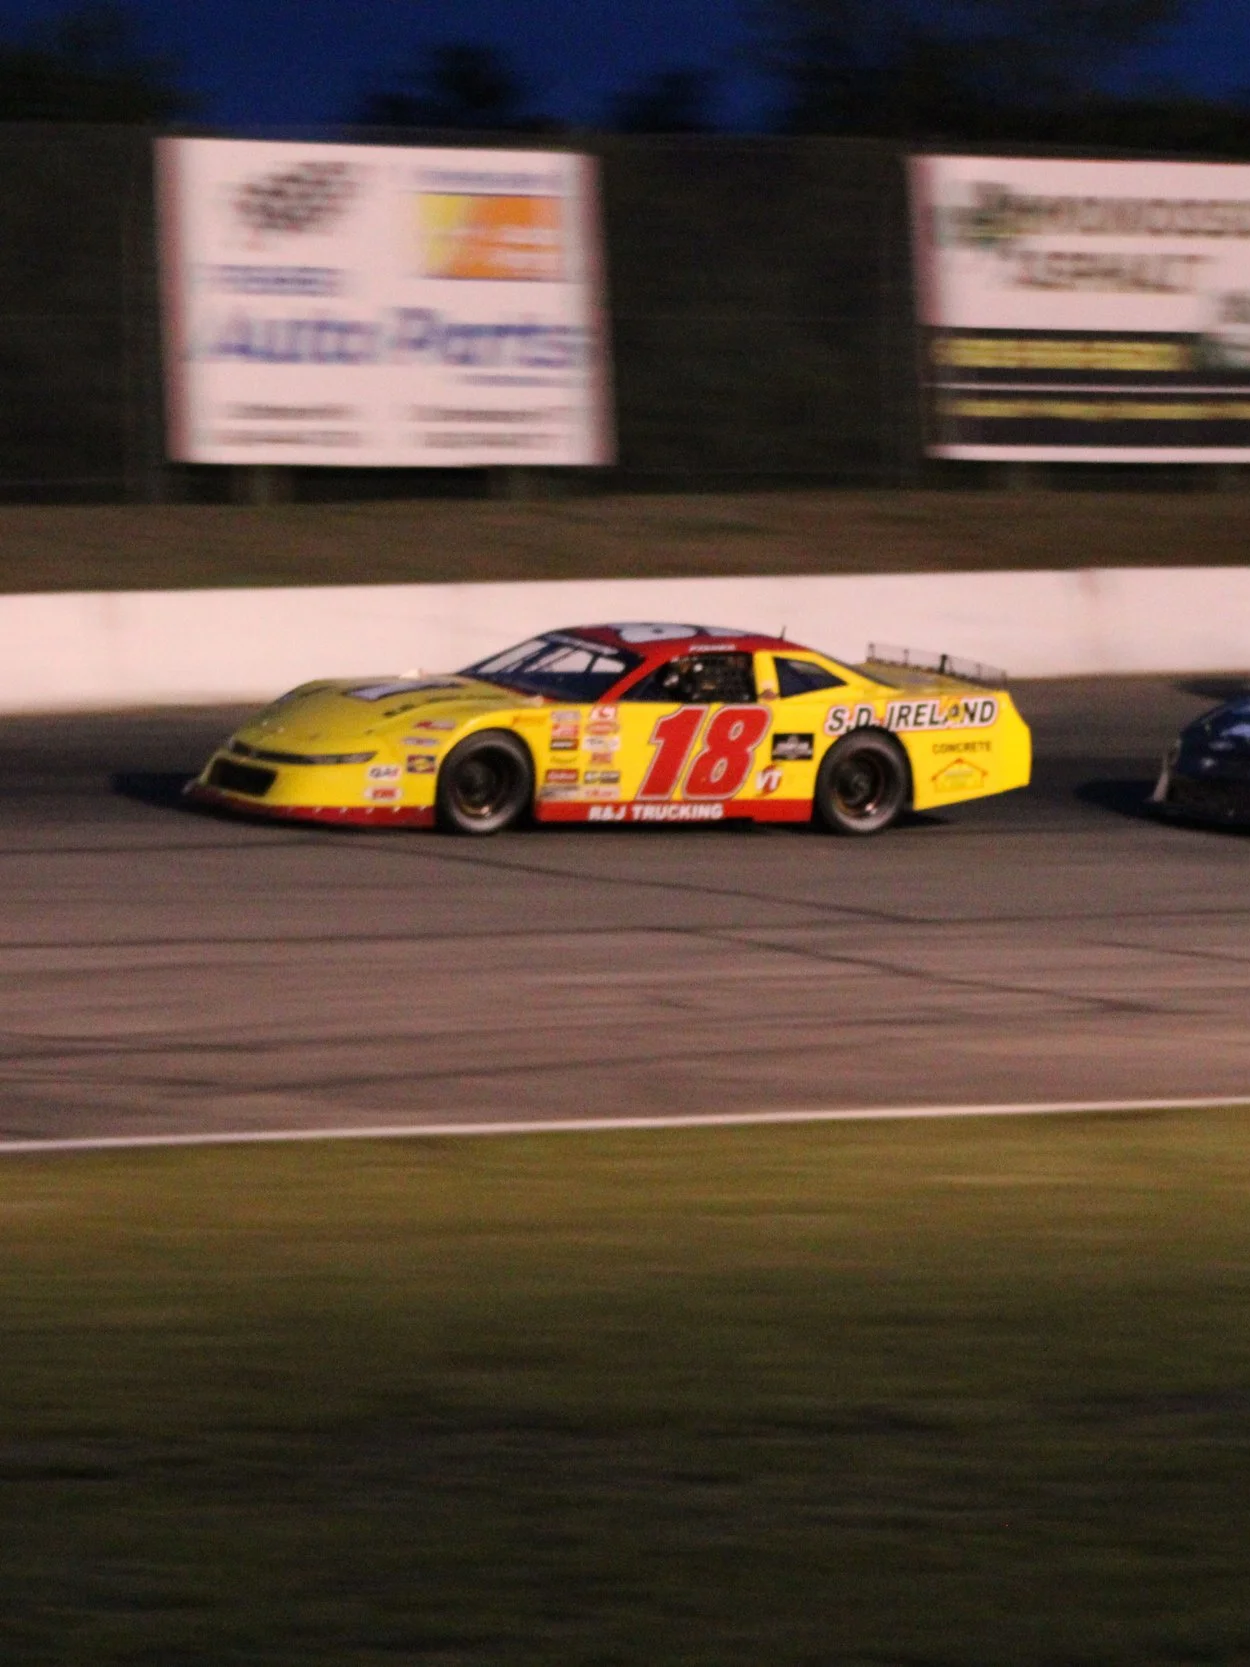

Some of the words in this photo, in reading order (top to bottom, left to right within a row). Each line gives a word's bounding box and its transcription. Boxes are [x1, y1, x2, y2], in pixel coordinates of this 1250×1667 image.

[887, 699, 996, 733] IRELAND
[634, 704, 772, 801] 18
[633, 803, 724, 820] TRUCKING
